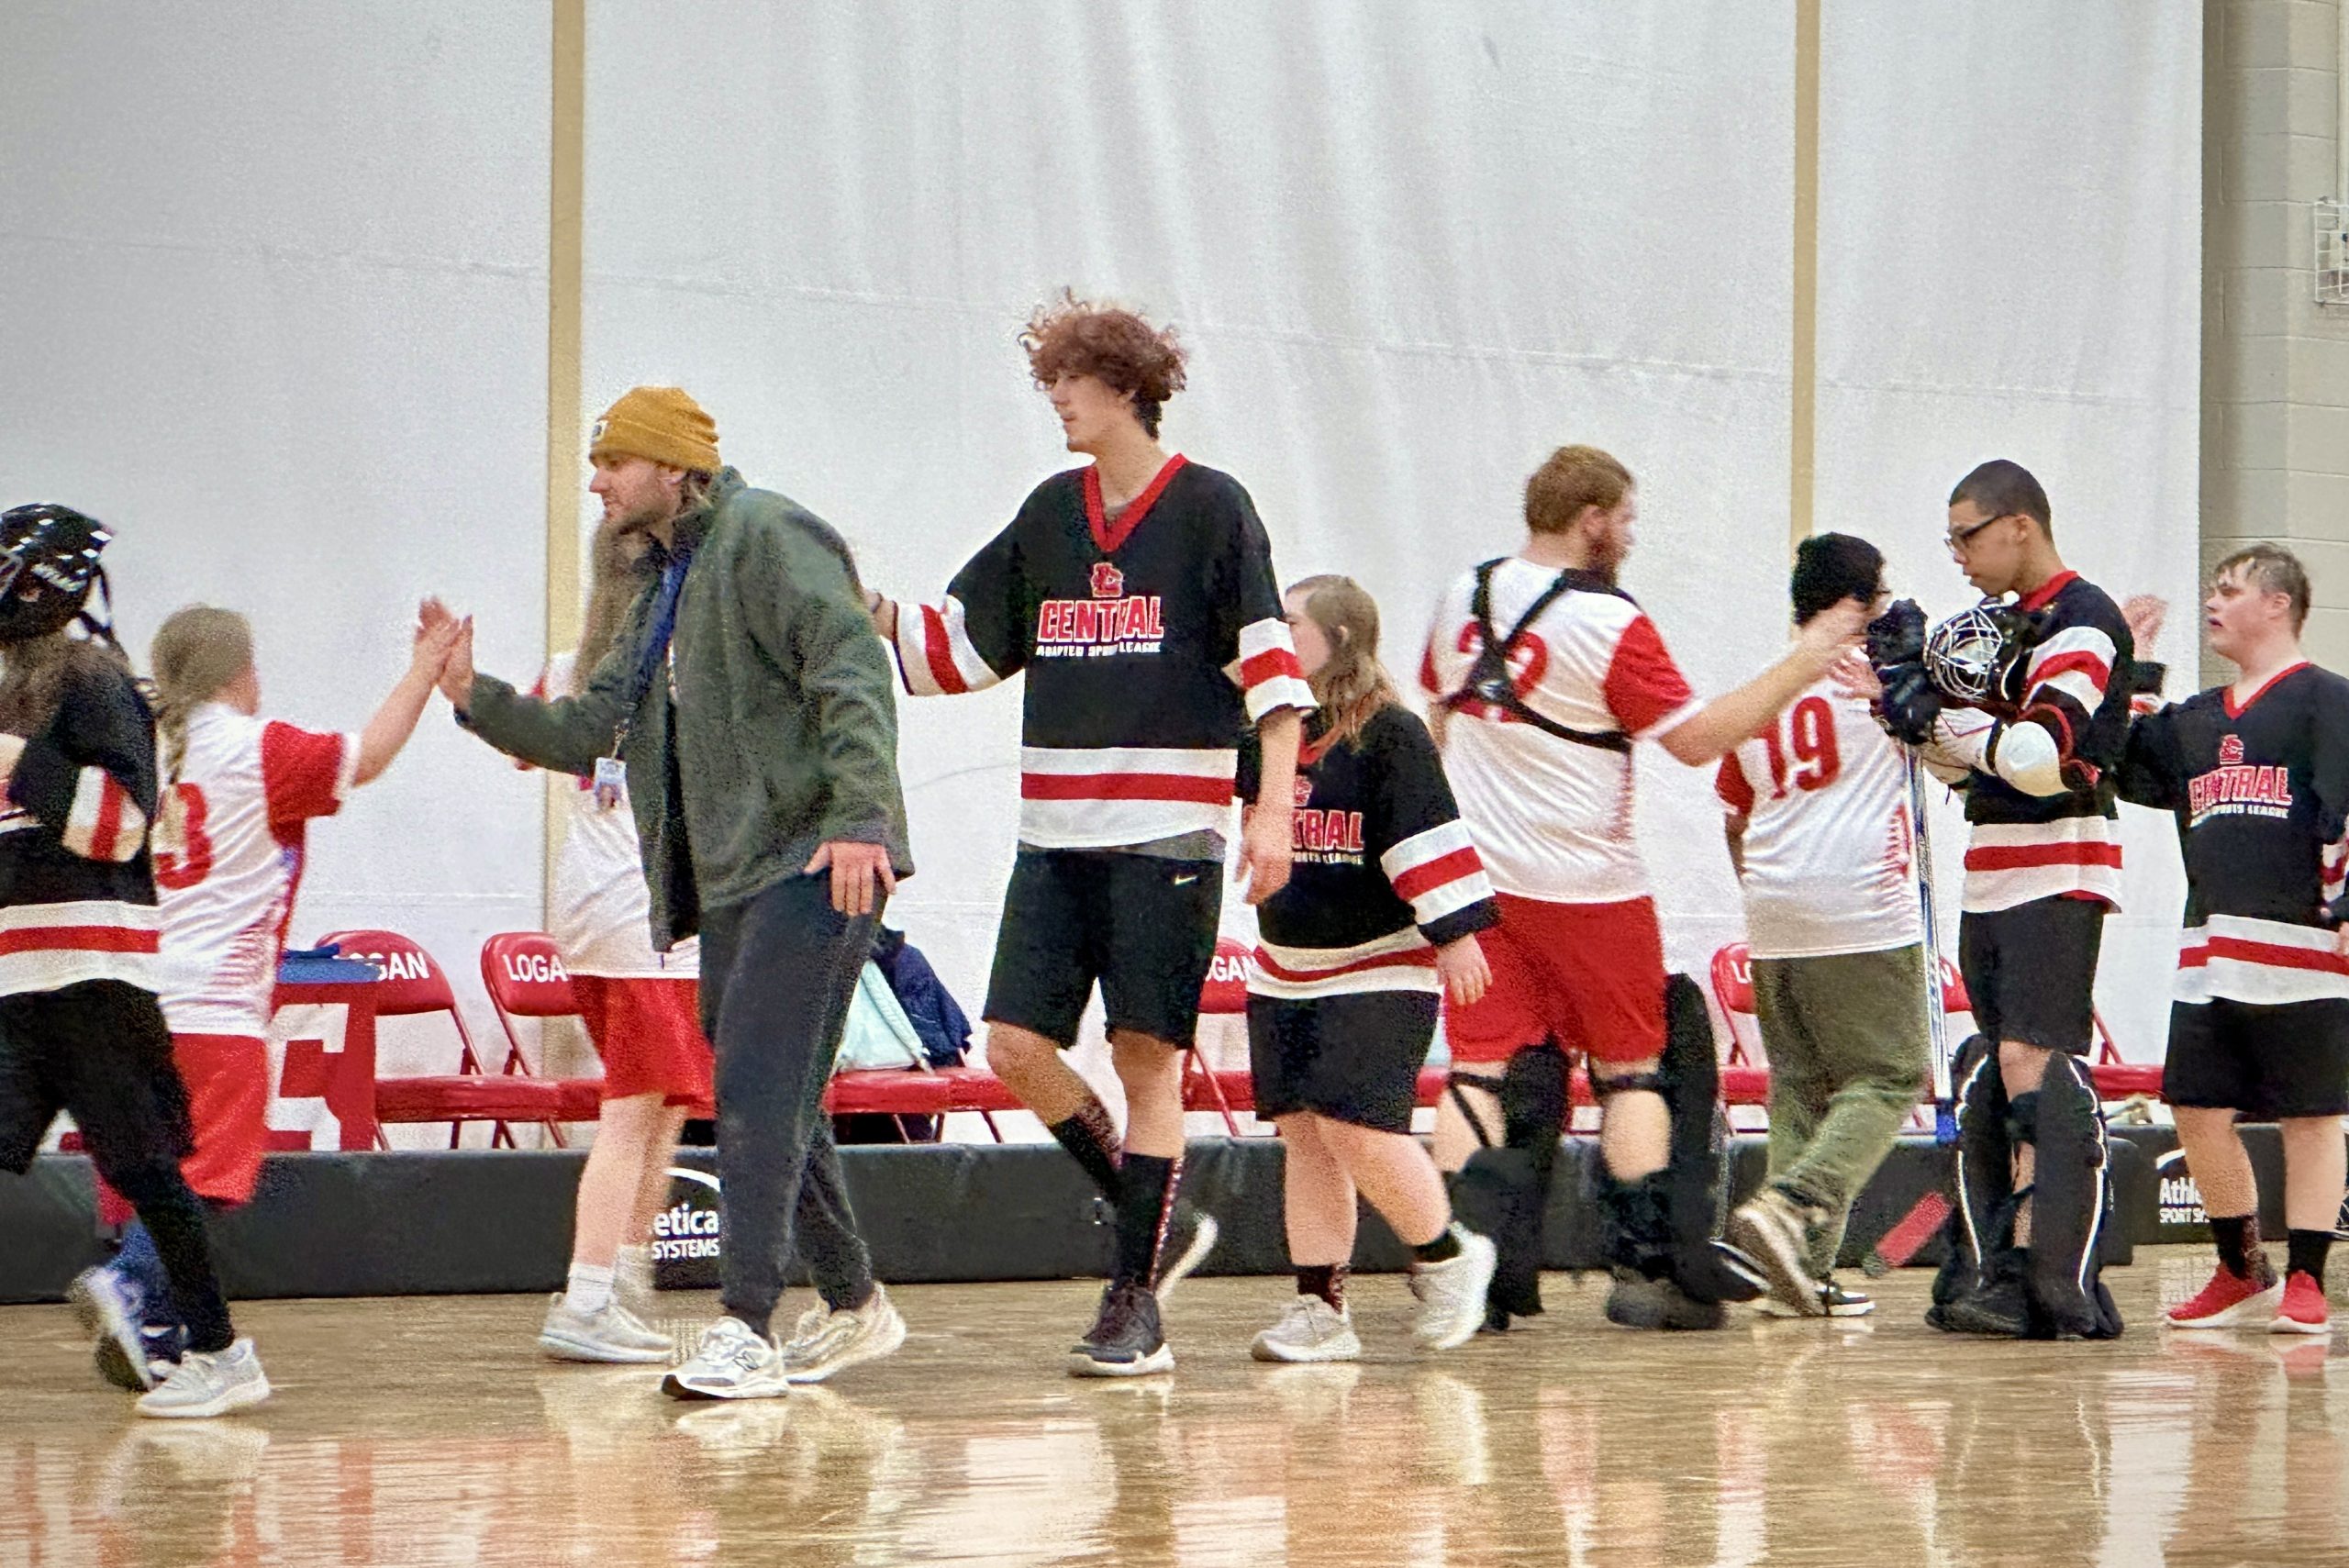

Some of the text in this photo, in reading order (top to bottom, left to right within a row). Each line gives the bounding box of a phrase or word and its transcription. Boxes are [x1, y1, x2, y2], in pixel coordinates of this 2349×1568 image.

[1752, 696, 1841, 800] 19
[2188, 764, 2294, 817] CNTRAL
[651, 1239, 720, 1260] SYSTEMS
